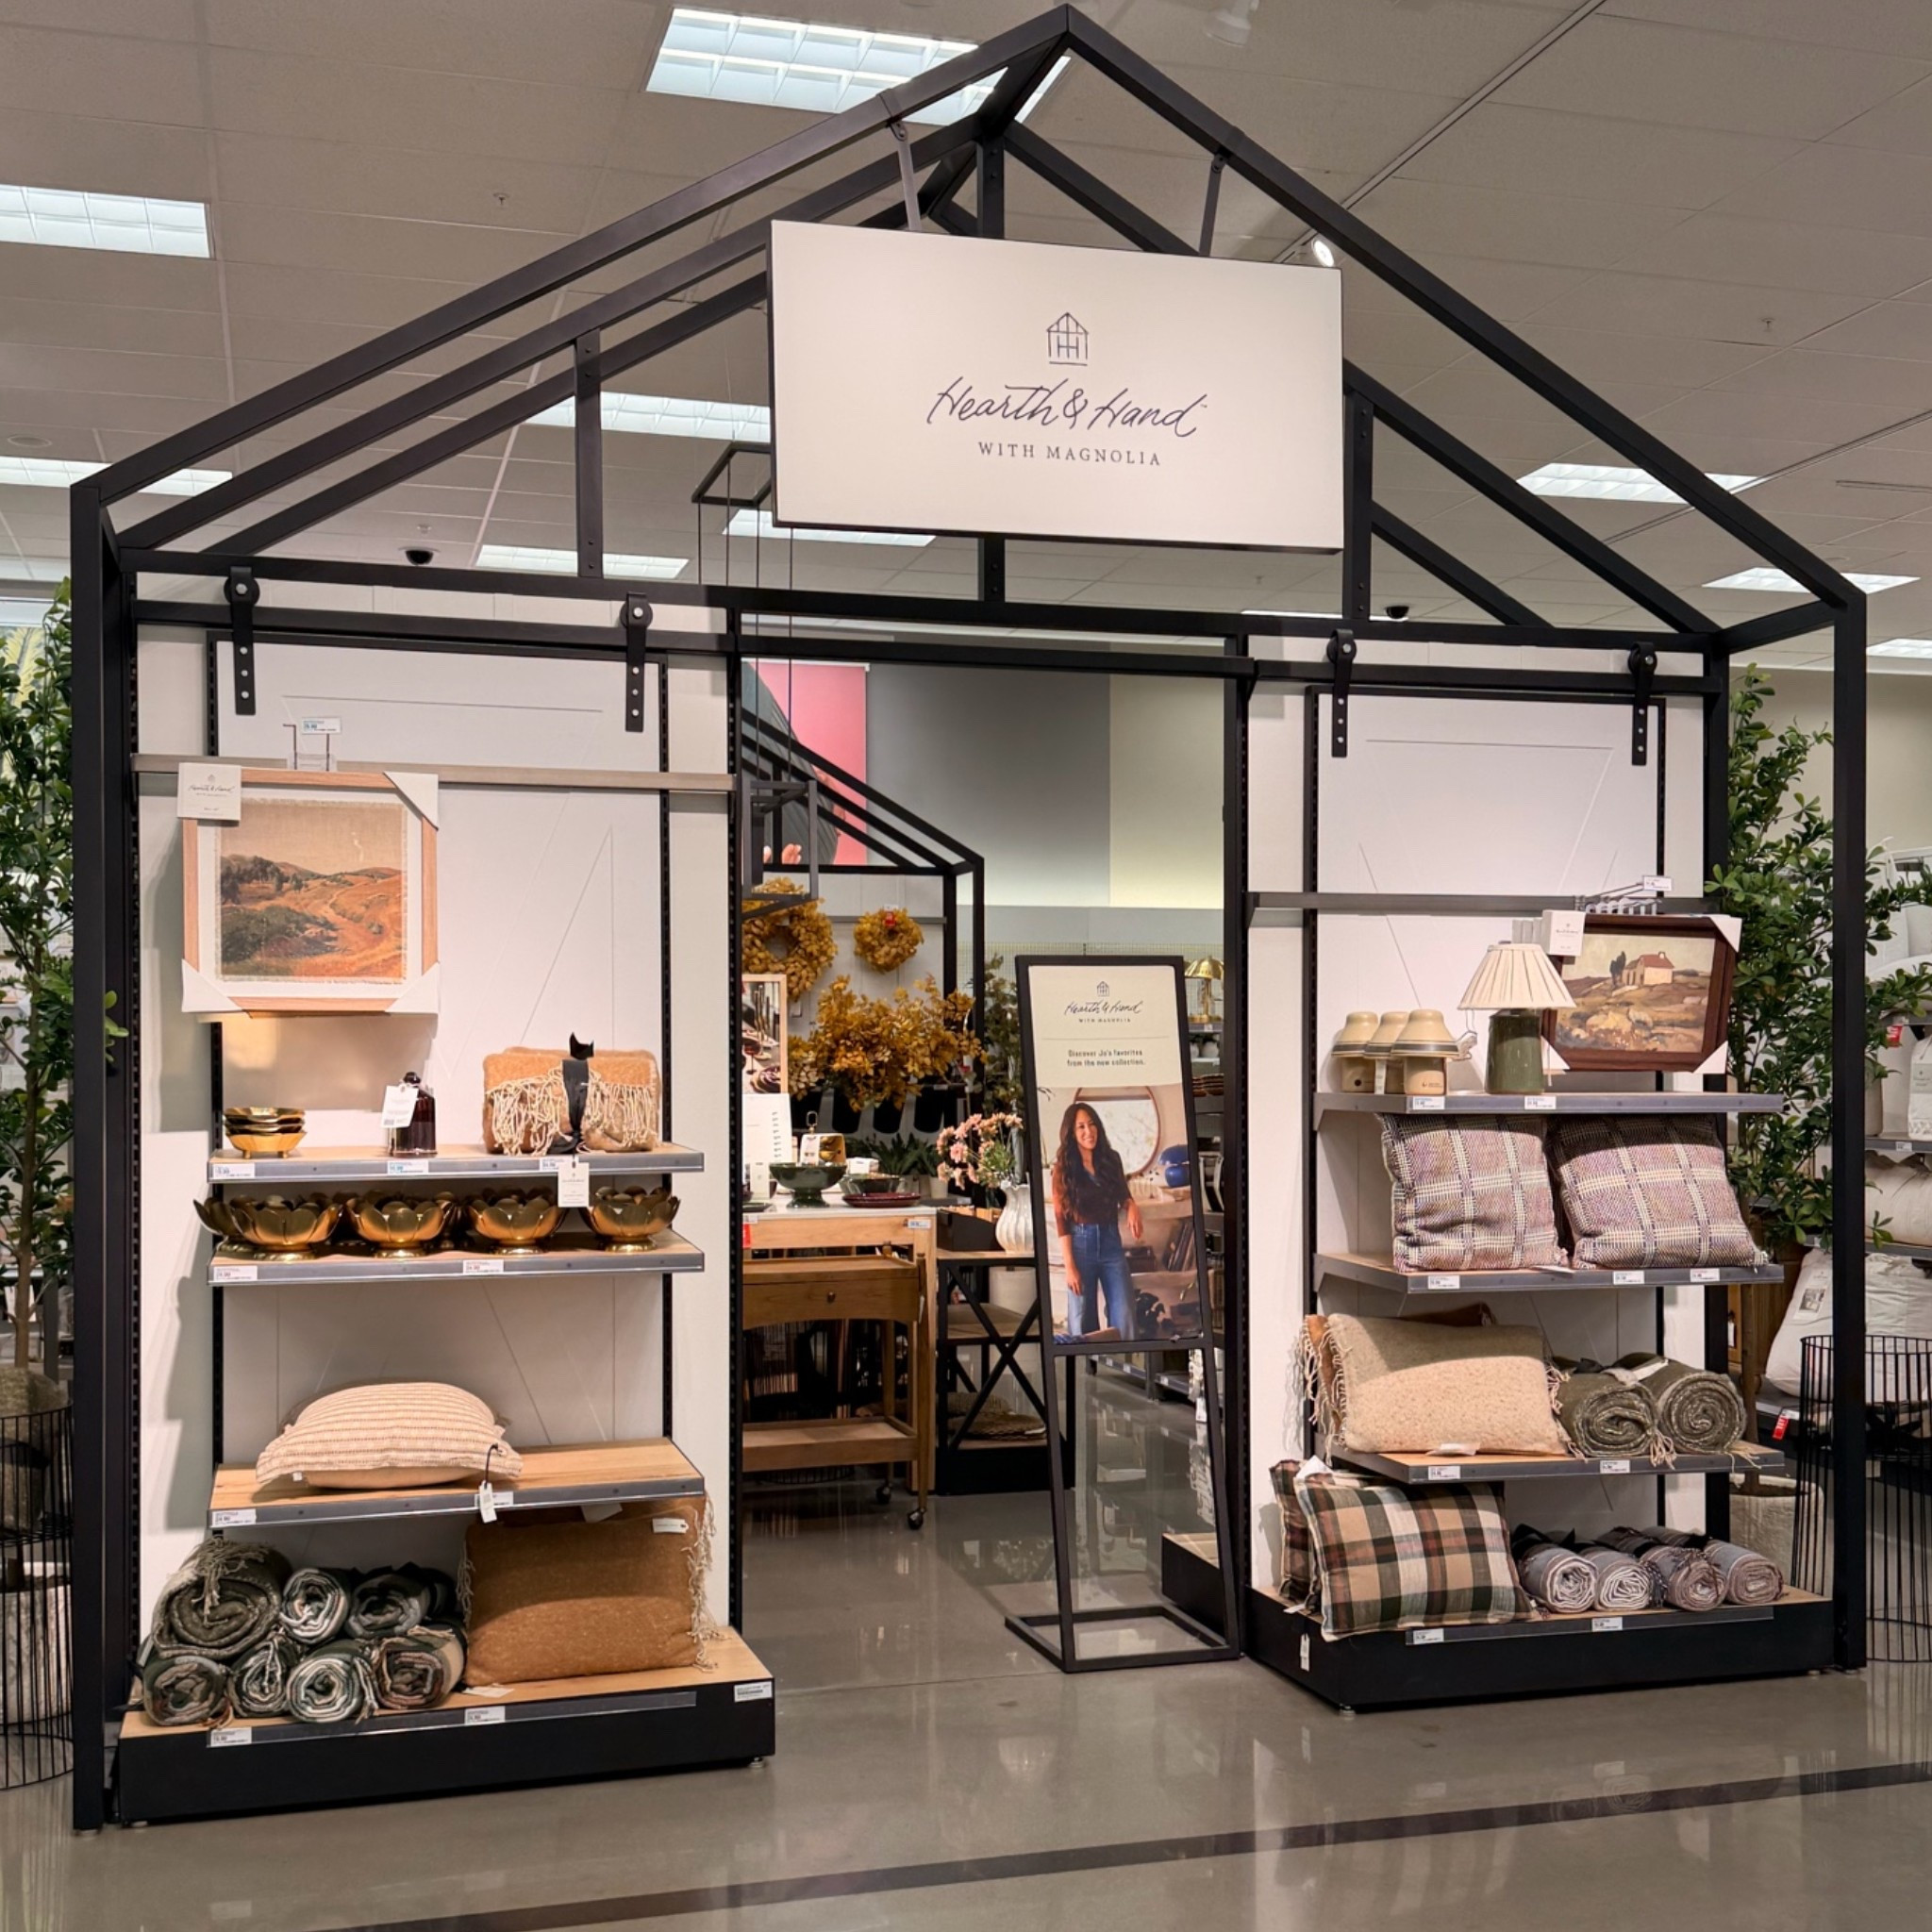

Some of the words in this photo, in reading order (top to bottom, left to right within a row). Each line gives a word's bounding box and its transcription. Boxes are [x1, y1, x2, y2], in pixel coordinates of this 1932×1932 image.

[927, 376, 1070, 426] Hearth
[1062, 389, 1088, 429] &
[1088, 388, 1208, 438] Hand
[977, 441, 1036, 459] WITH
[1046, 445, 1162, 467] MAGNOLIA
[1064, 1000, 1104, 1015] Hearth
[1109, 1000, 1143, 1014] Hand
[1068, 1049, 1096, 1058] Discover
[1098, 1049, 1112, 1058] Jo's
